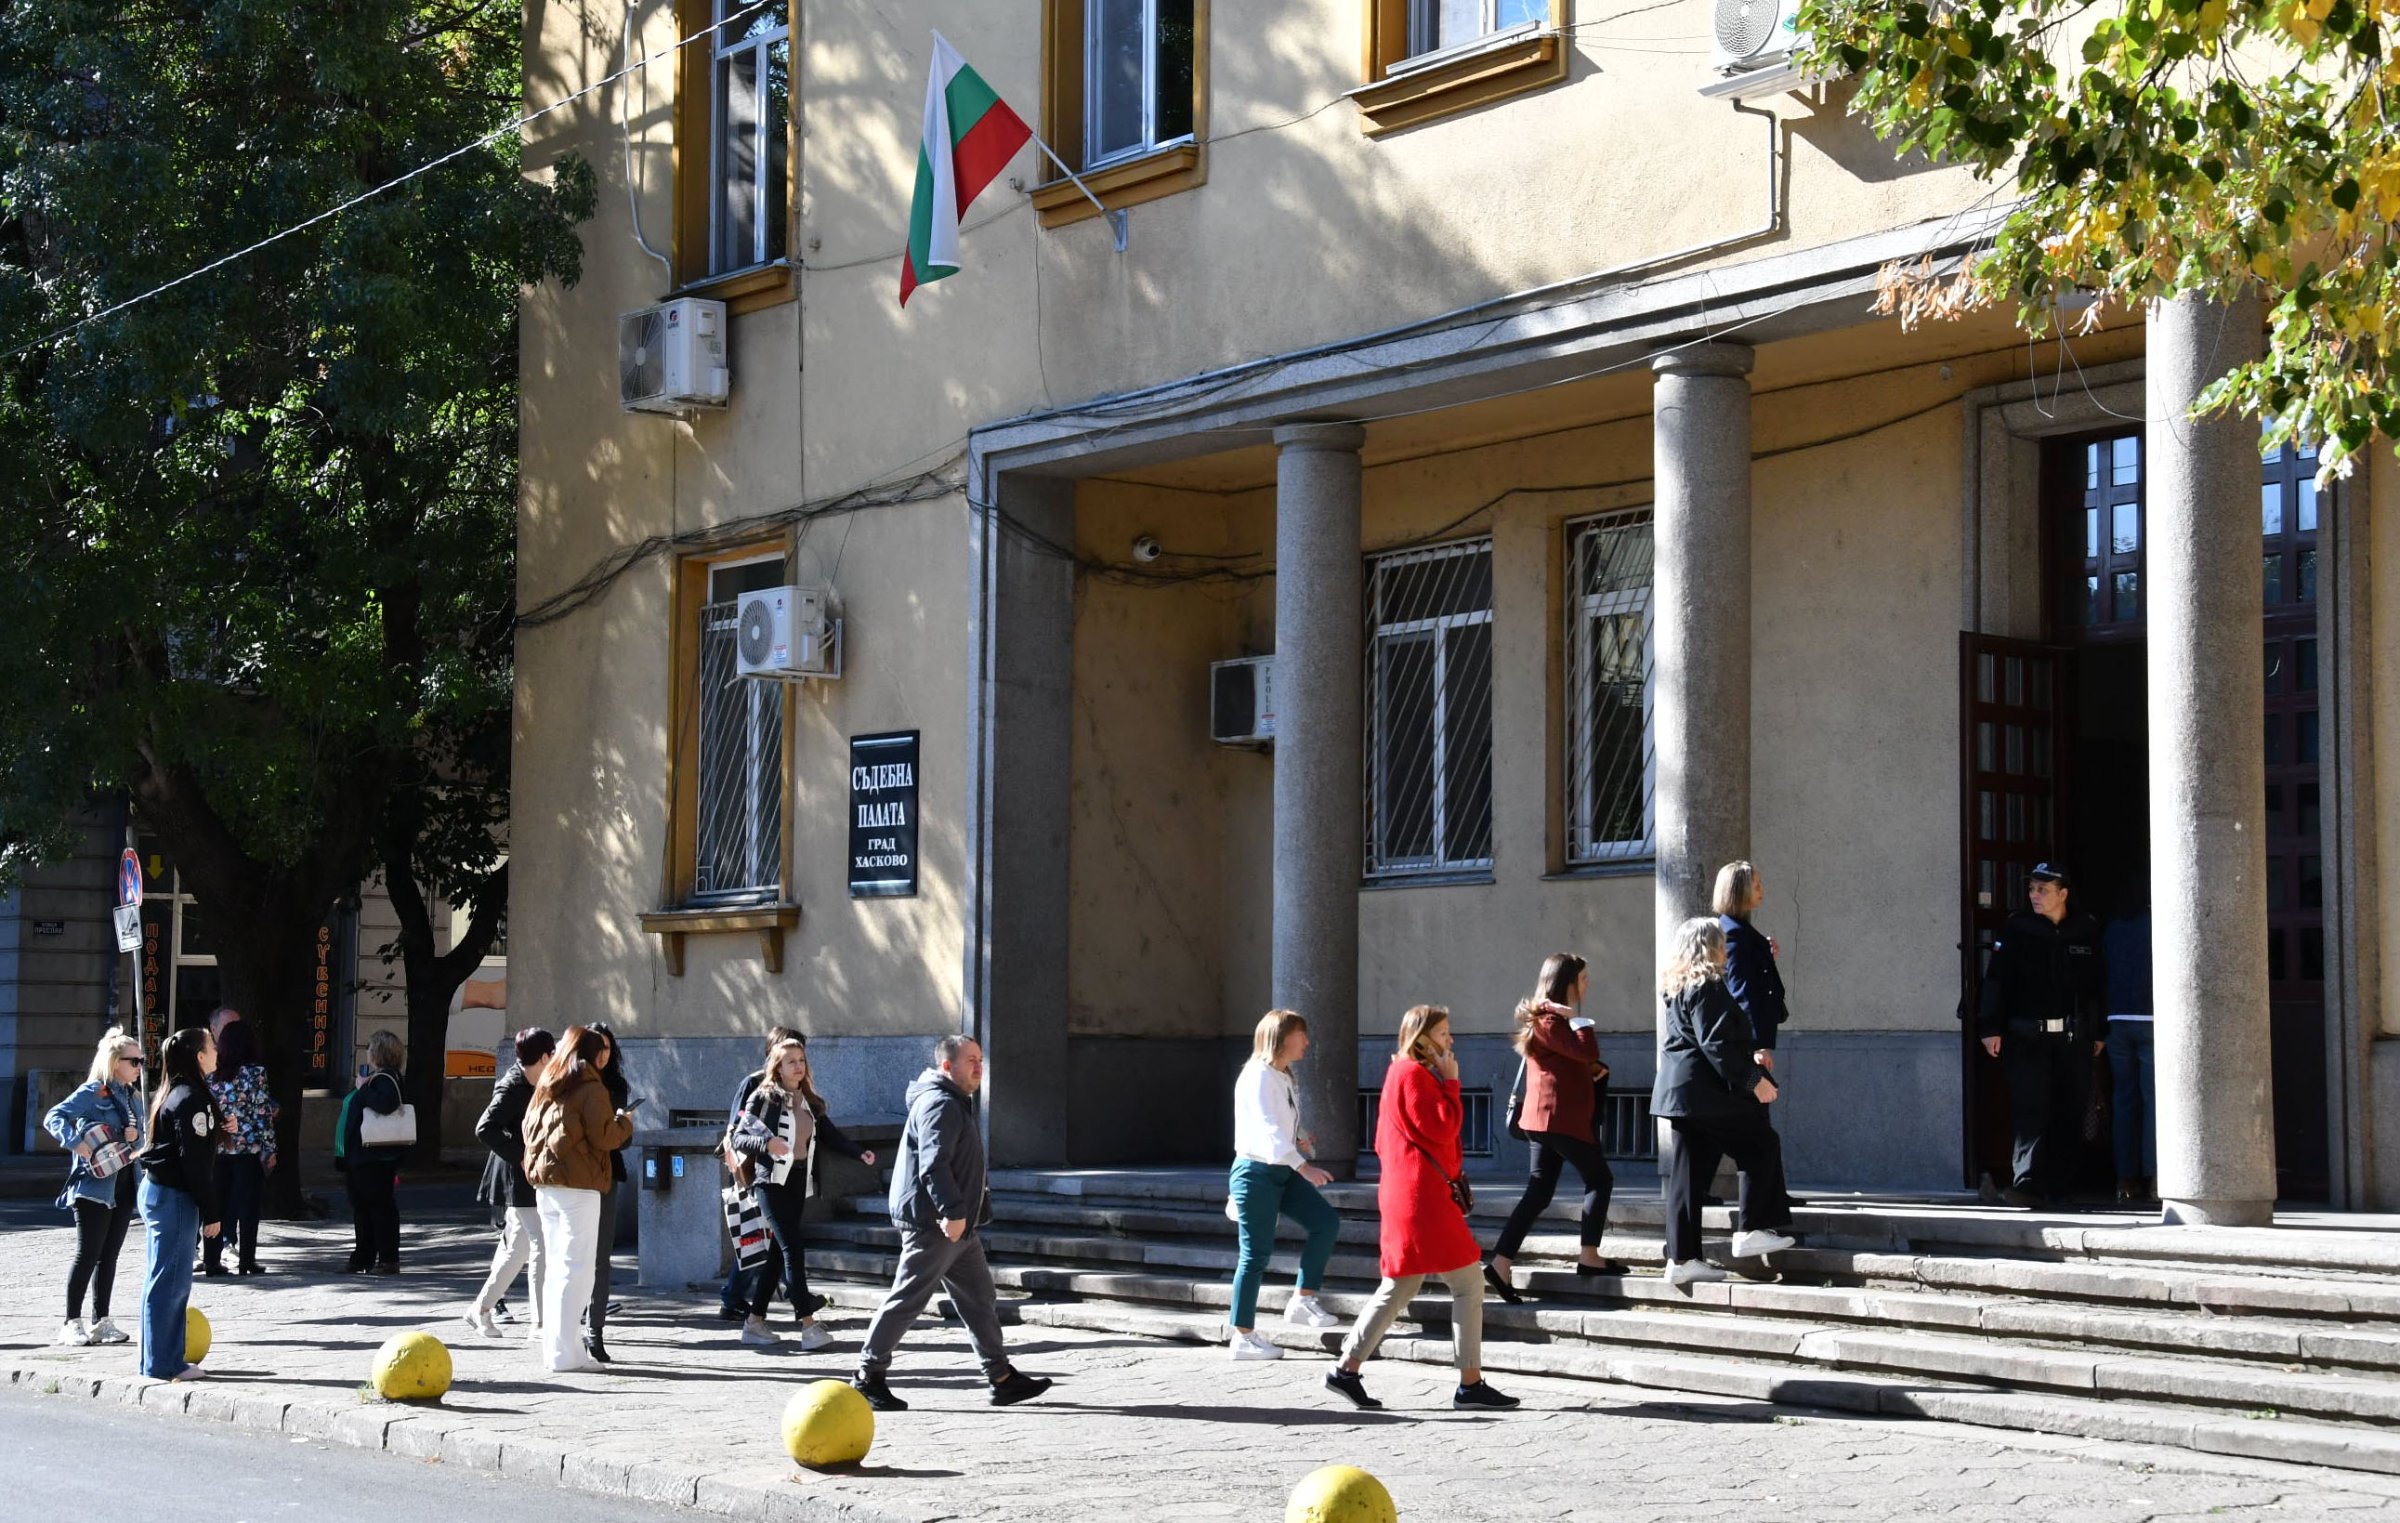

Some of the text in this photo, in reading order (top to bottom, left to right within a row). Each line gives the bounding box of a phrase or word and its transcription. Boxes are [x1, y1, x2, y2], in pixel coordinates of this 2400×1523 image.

[852, 763, 913, 796] СЪДЕБНА
[857, 801, 906, 828] ПАЛАТА
[868, 837, 896, 852] ГРАД
[855, 854, 908, 868] ХАСКОВО
